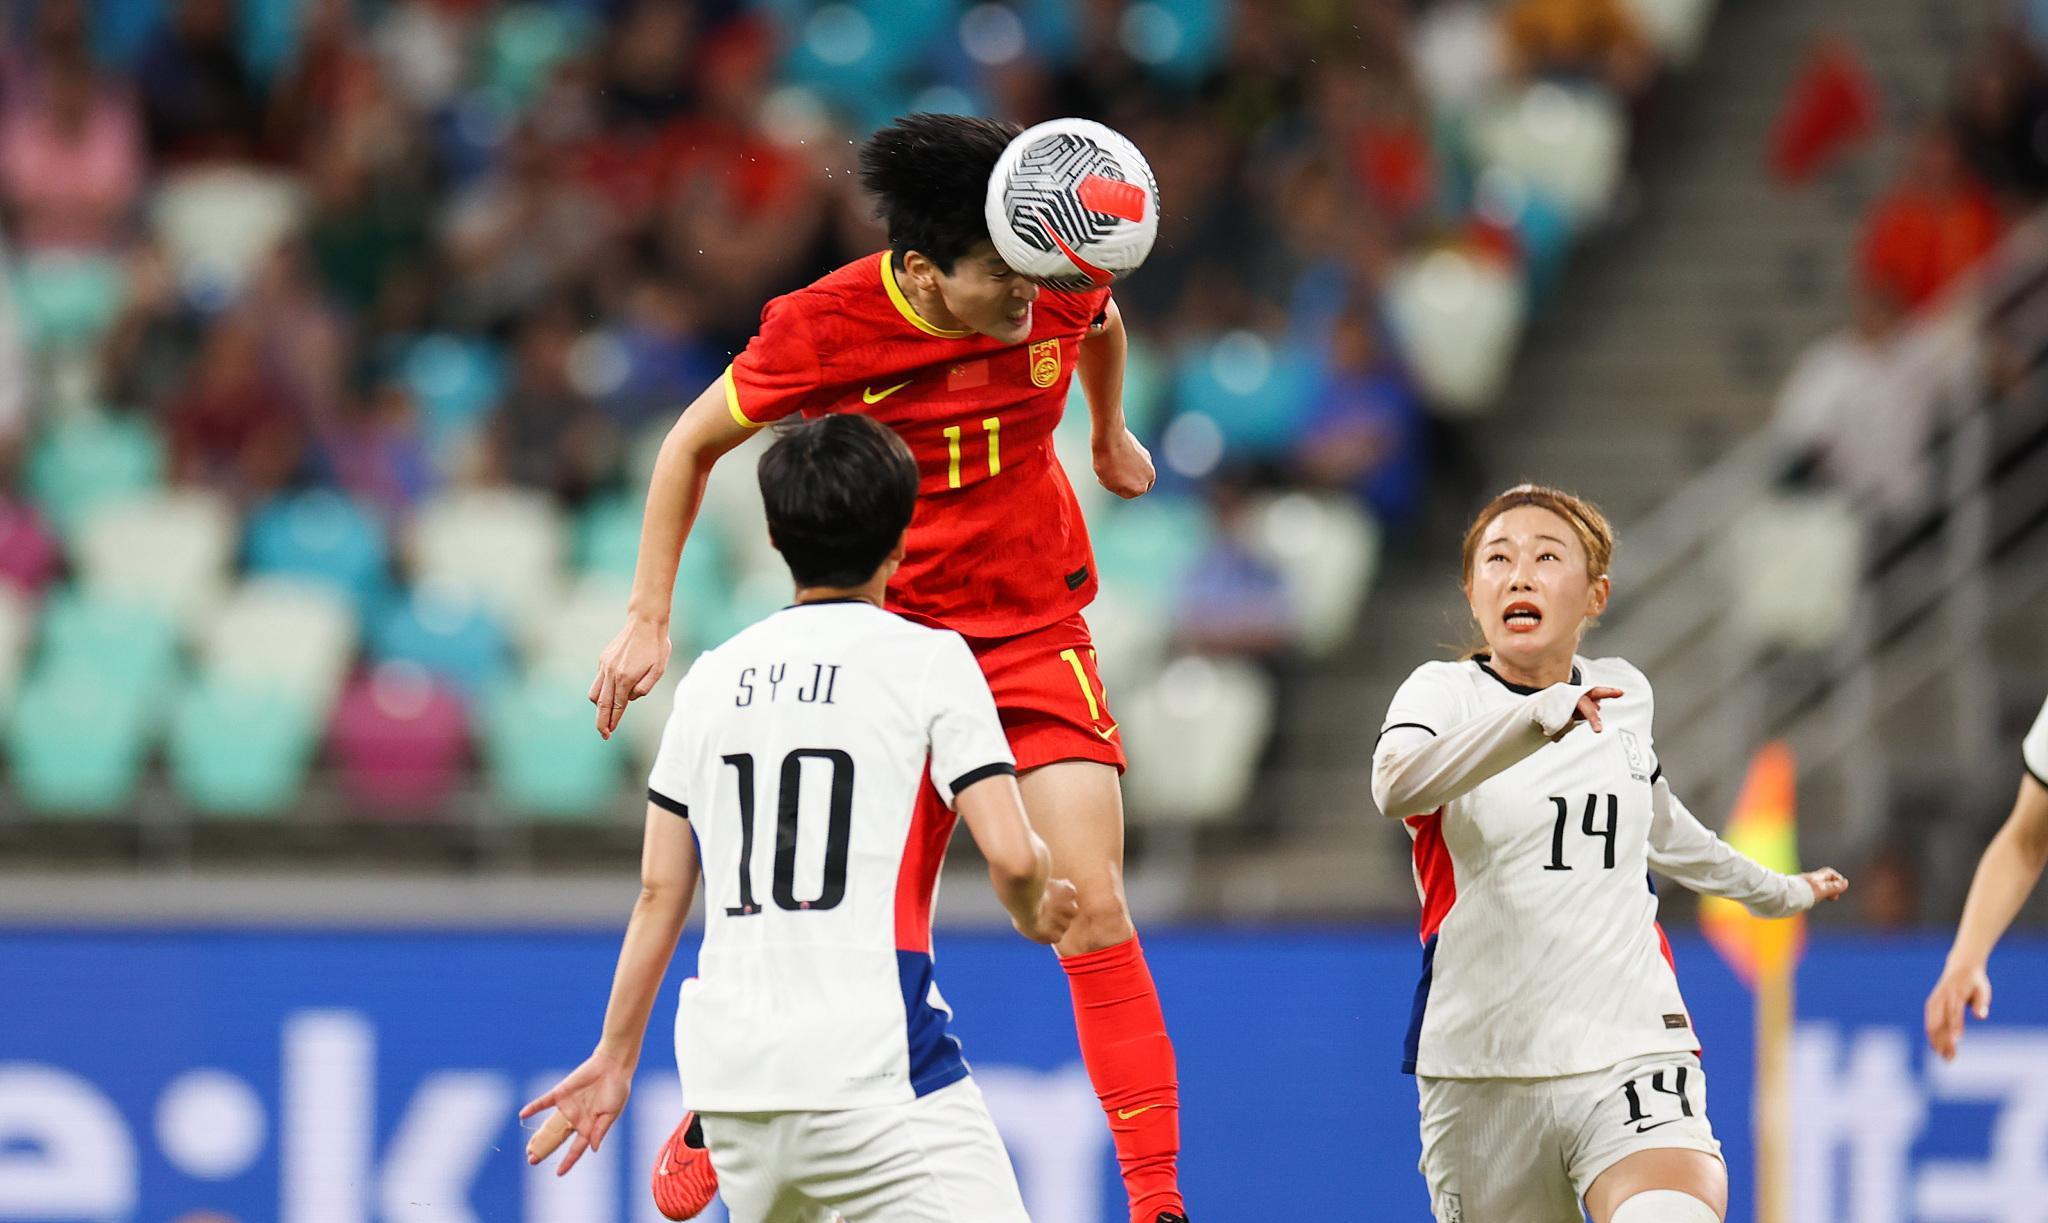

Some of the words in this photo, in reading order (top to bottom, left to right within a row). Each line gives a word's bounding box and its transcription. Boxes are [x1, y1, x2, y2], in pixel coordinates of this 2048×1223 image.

[942, 416, 1001, 489] 11
[798, 663, 842, 704] JI
[721, 747, 855, 917] 10
[1542, 792, 1618, 870] 14
[1622, 1066, 1694, 1126] 14
